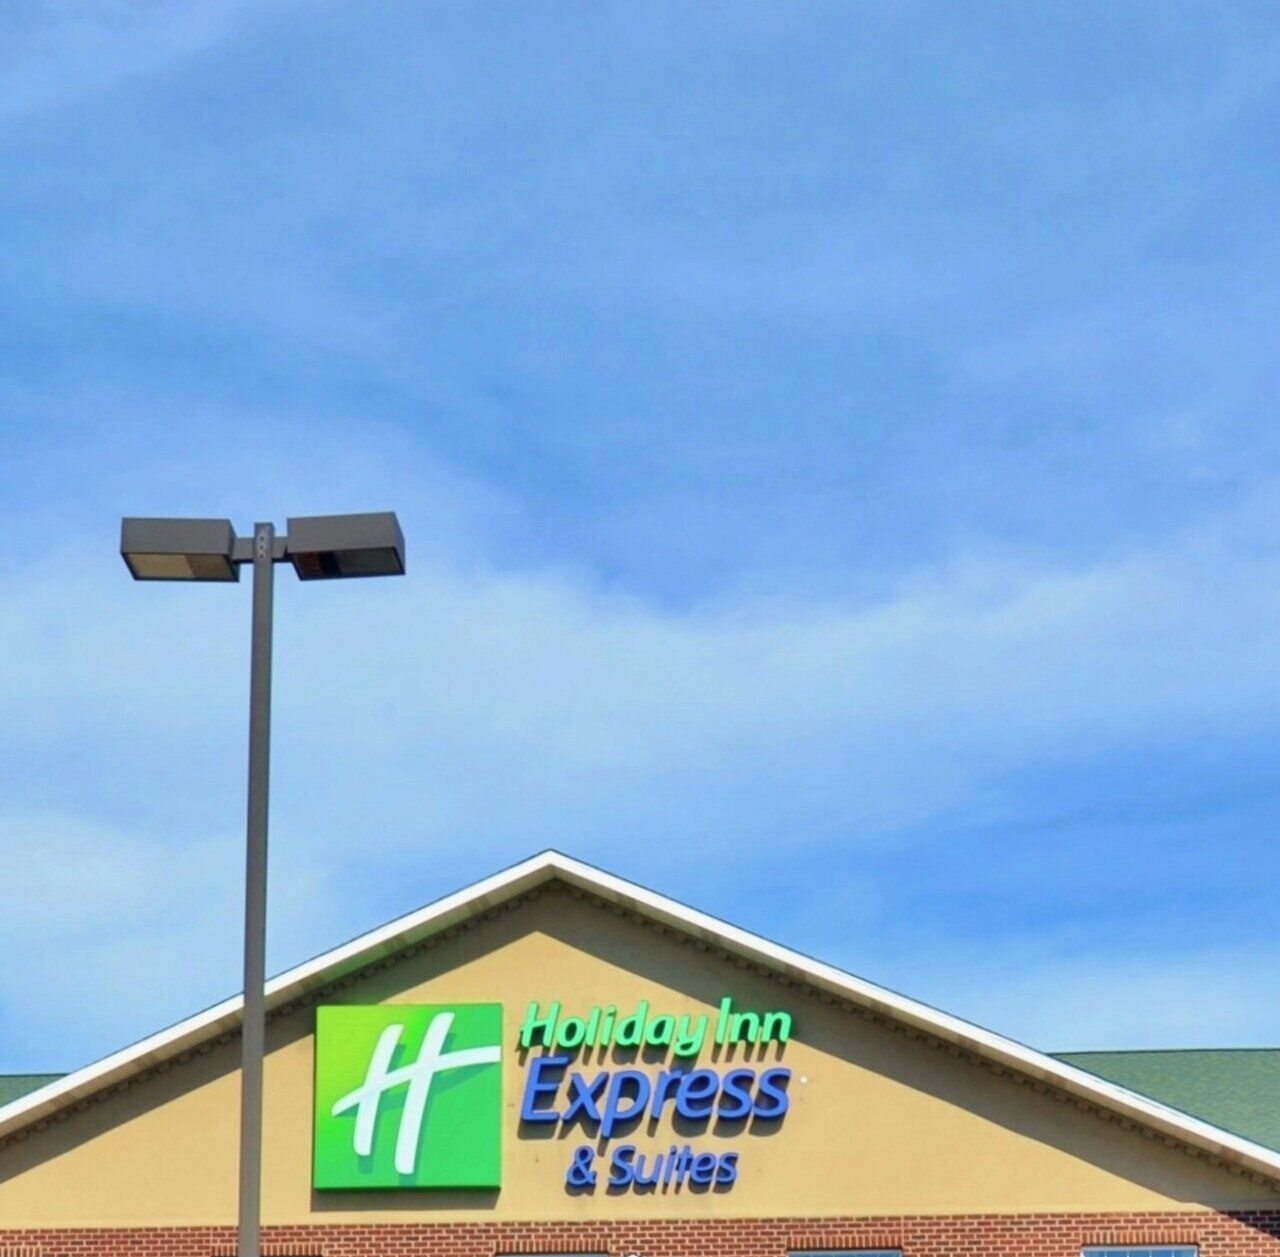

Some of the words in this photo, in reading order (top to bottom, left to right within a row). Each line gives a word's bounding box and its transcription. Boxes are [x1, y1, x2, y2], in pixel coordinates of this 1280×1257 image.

[519, 1000, 708, 1057] Holiday
[714, 997, 792, 1045] Inn
[520, 1055, 792, 1138] Express
[566, 1145, 596, 1186] &
[608, 1144, 740, 1186] Suites
